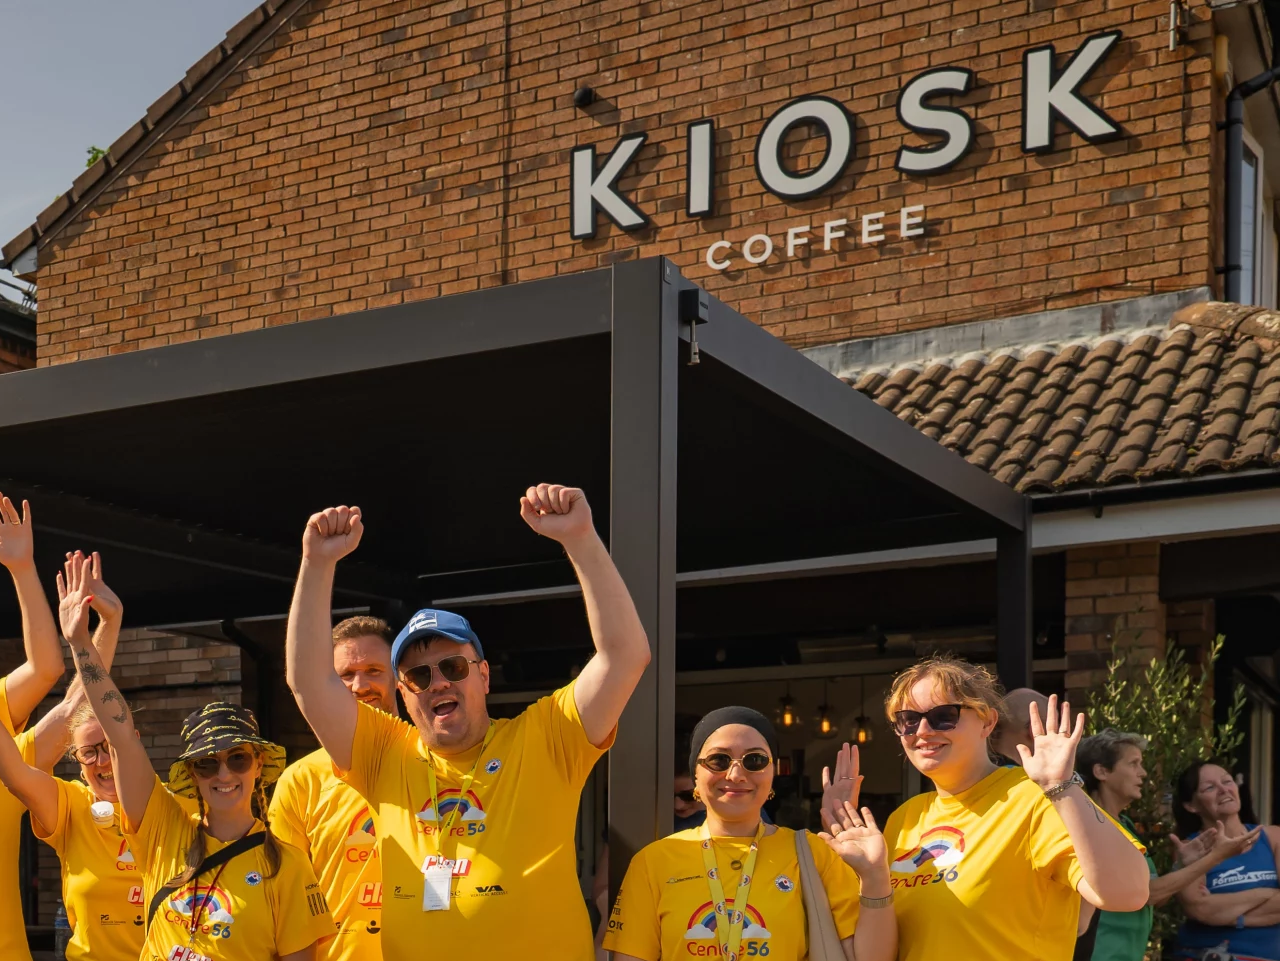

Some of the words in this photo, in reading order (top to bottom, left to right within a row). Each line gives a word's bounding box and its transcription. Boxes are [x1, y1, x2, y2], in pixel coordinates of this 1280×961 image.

[569, 30, 1123, 240] KIOSK
[706, 204, 926, 271] COFFEE
[932, 865, 959, 884] 56
[475, 885, 504, 893] VA
[211, 923, 231, 939] 56
[747, 941, 770, 957] 56
